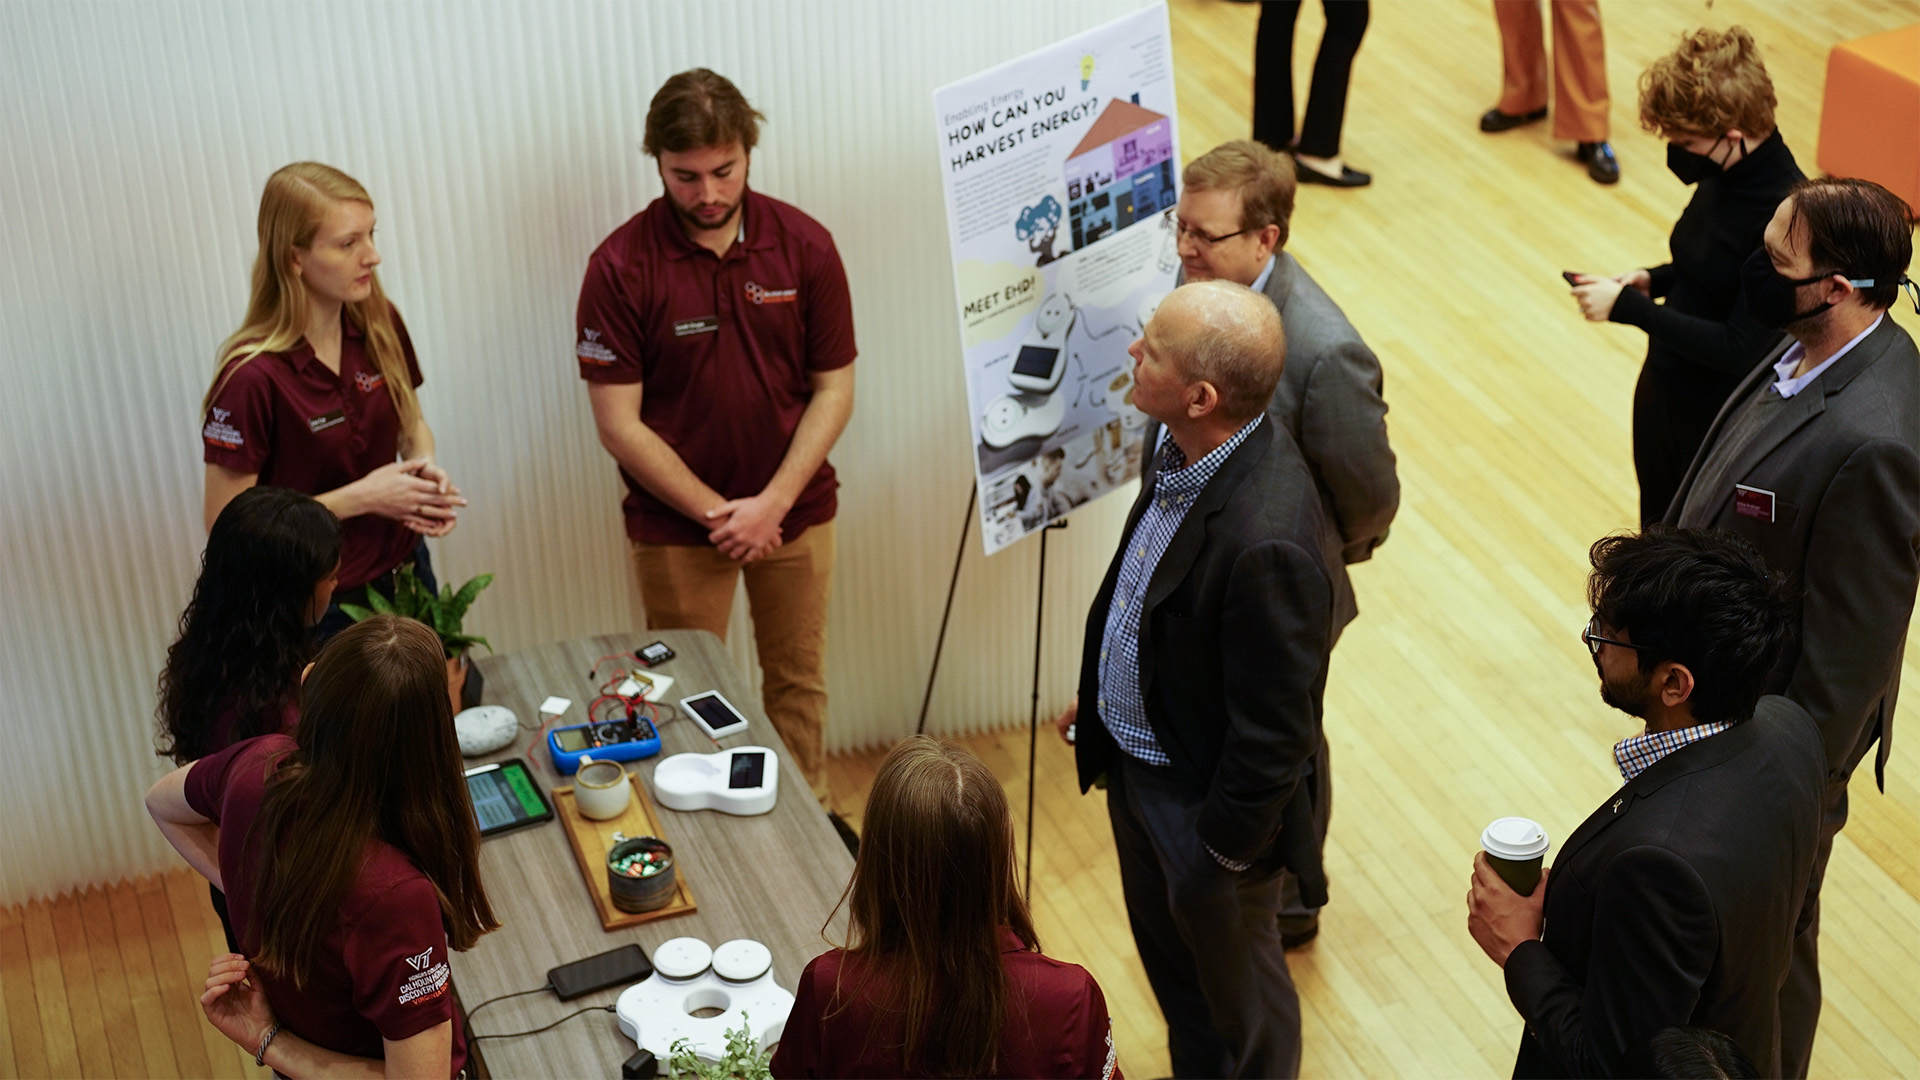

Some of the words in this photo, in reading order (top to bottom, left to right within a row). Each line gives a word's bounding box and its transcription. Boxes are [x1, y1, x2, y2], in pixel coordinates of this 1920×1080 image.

[945, 101, 989, 126] Enabling
[991, 88, 1025, 107] Energy
[948, 117, 986, 147] HOW
[992, 101, 1028, 128] CAN
[1033, 86, 1066, 111] YOU
[950, 128, 1026, 172] HARVEST
[1031, 97, 1099, 139] ENERGY?
[963, 292, 999, 319] MEET
[1005, 275, 1035, 301] EHD!
[405, 946, 434, 972] VT
[398, 984, 435, 1005] DISCOVERY
[400, 975, 434, 994] CALHOUN
[412, 990, 442, 1005] VIRGINIA
